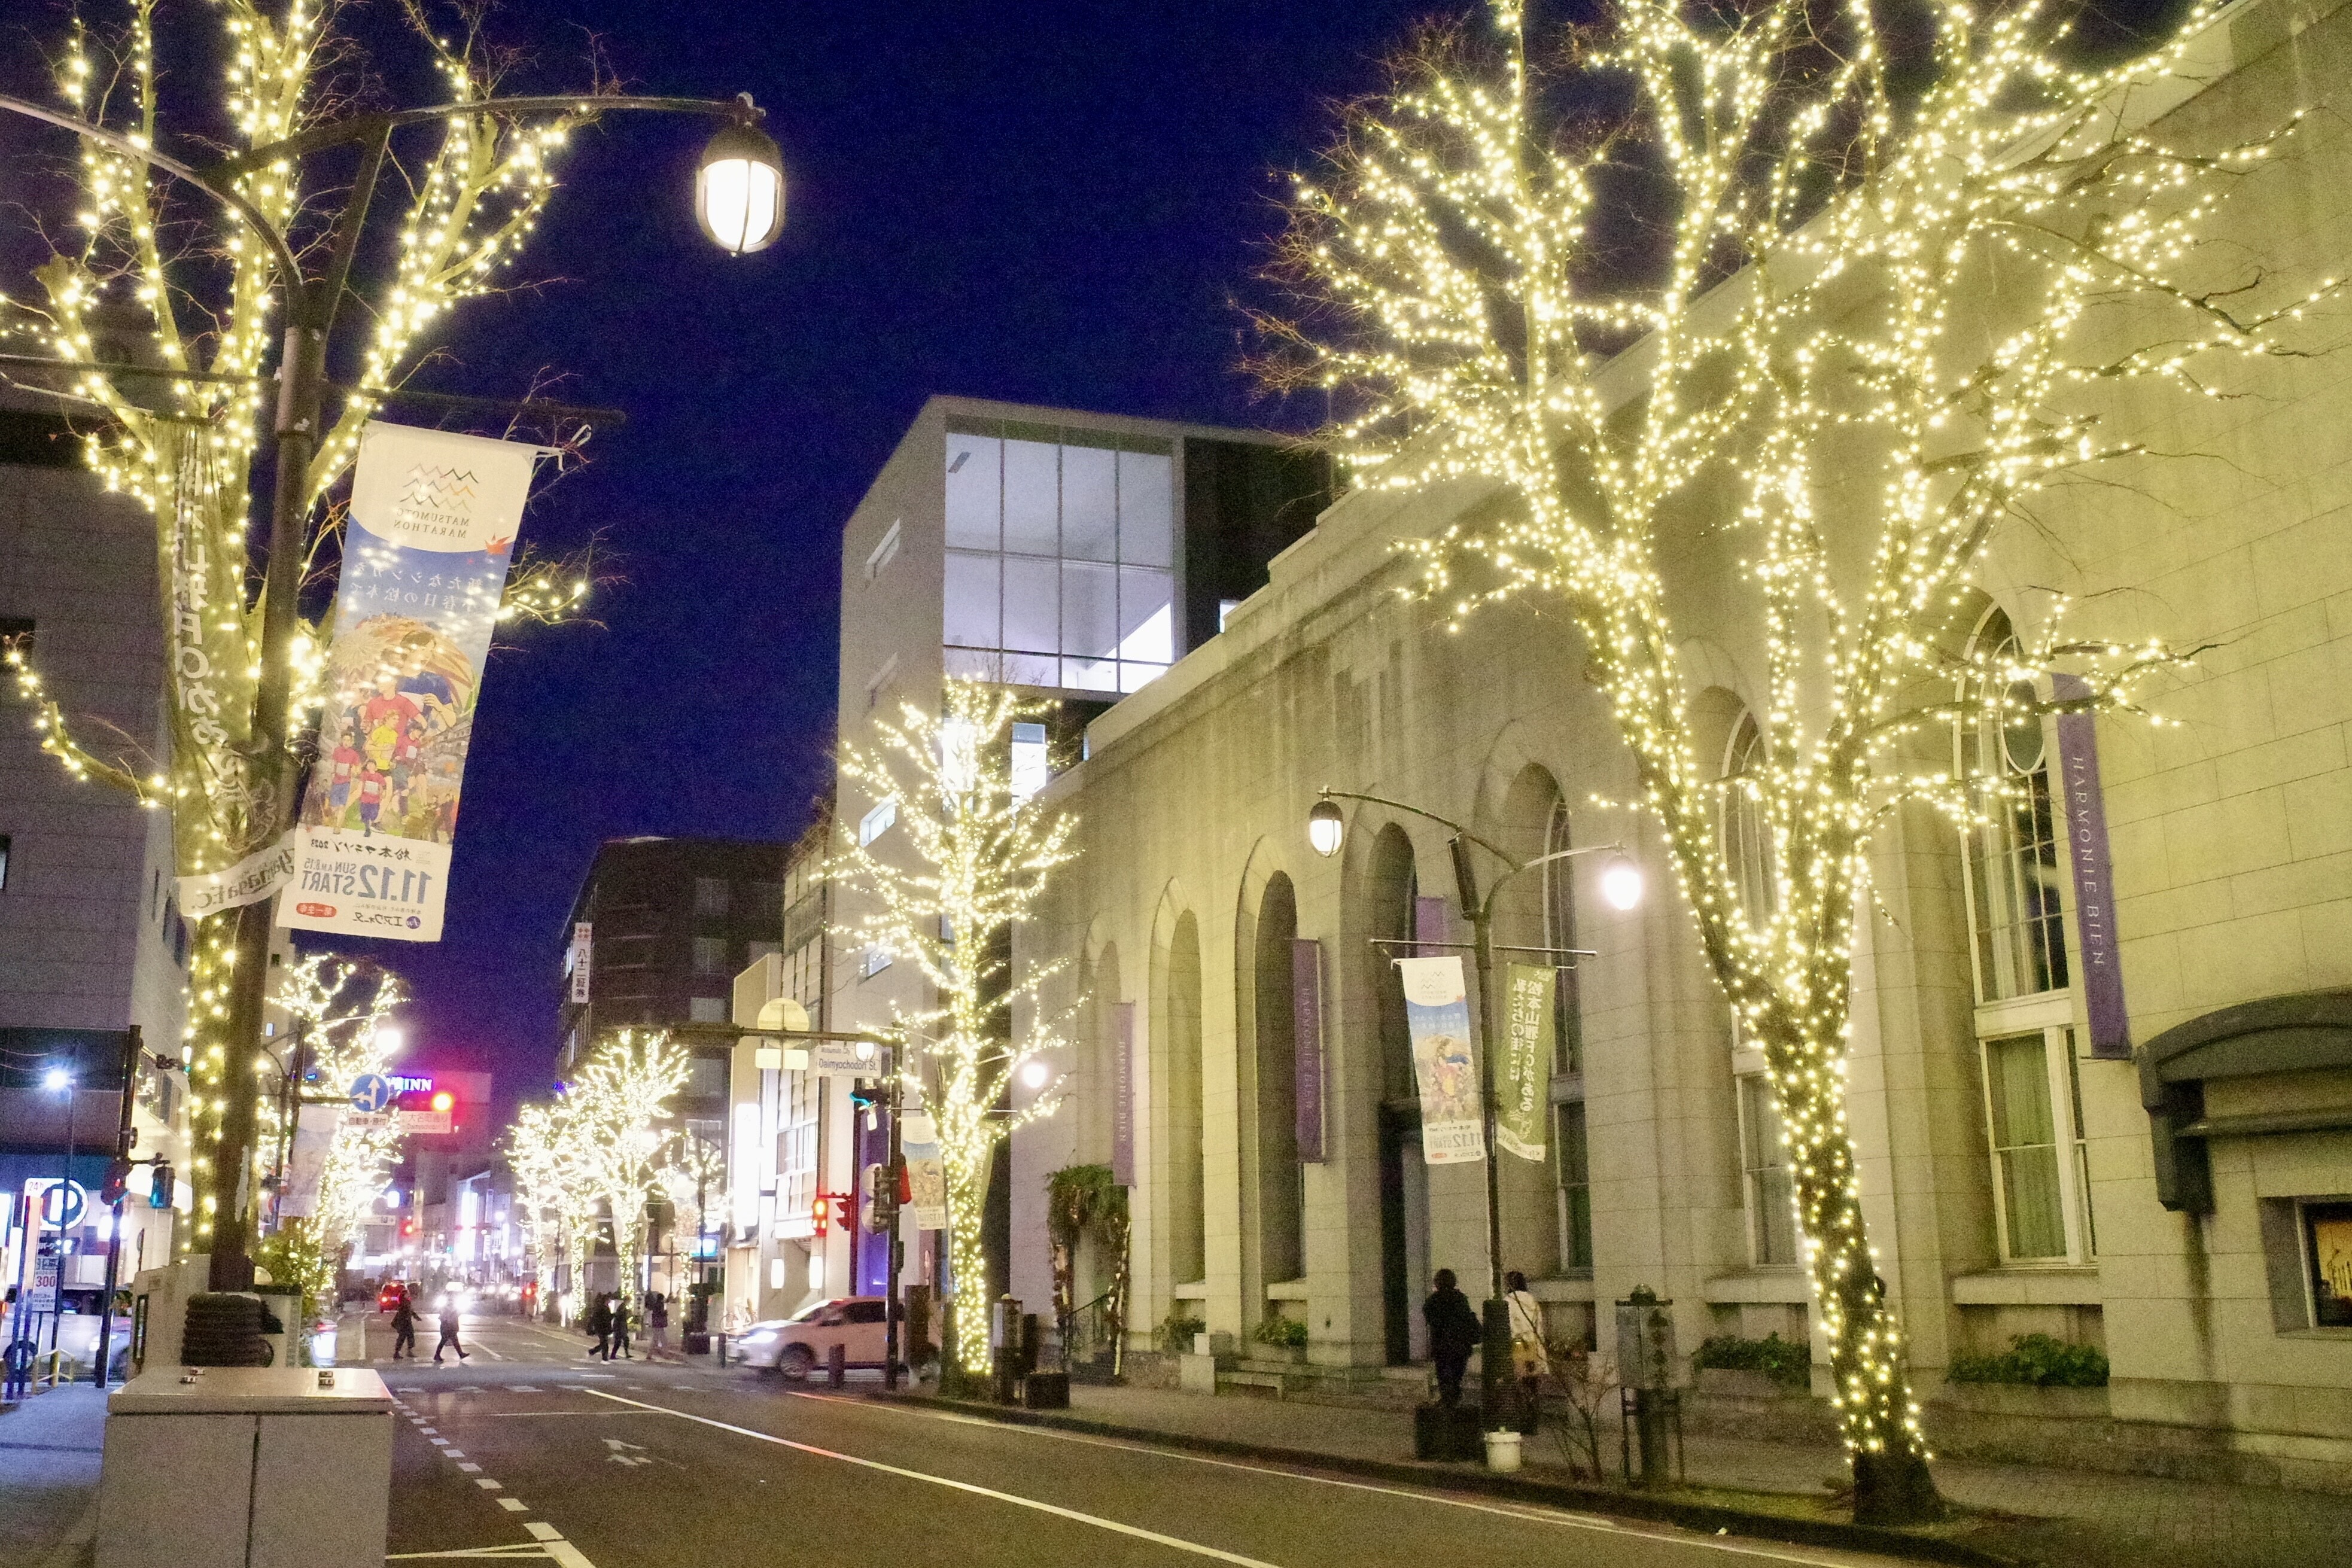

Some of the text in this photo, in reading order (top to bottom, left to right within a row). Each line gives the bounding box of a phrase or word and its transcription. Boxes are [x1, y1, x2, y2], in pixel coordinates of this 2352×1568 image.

[2072, 757, 2105, 966] HARMONIE BIEN
[36, 1276, 56, 1287] 300
